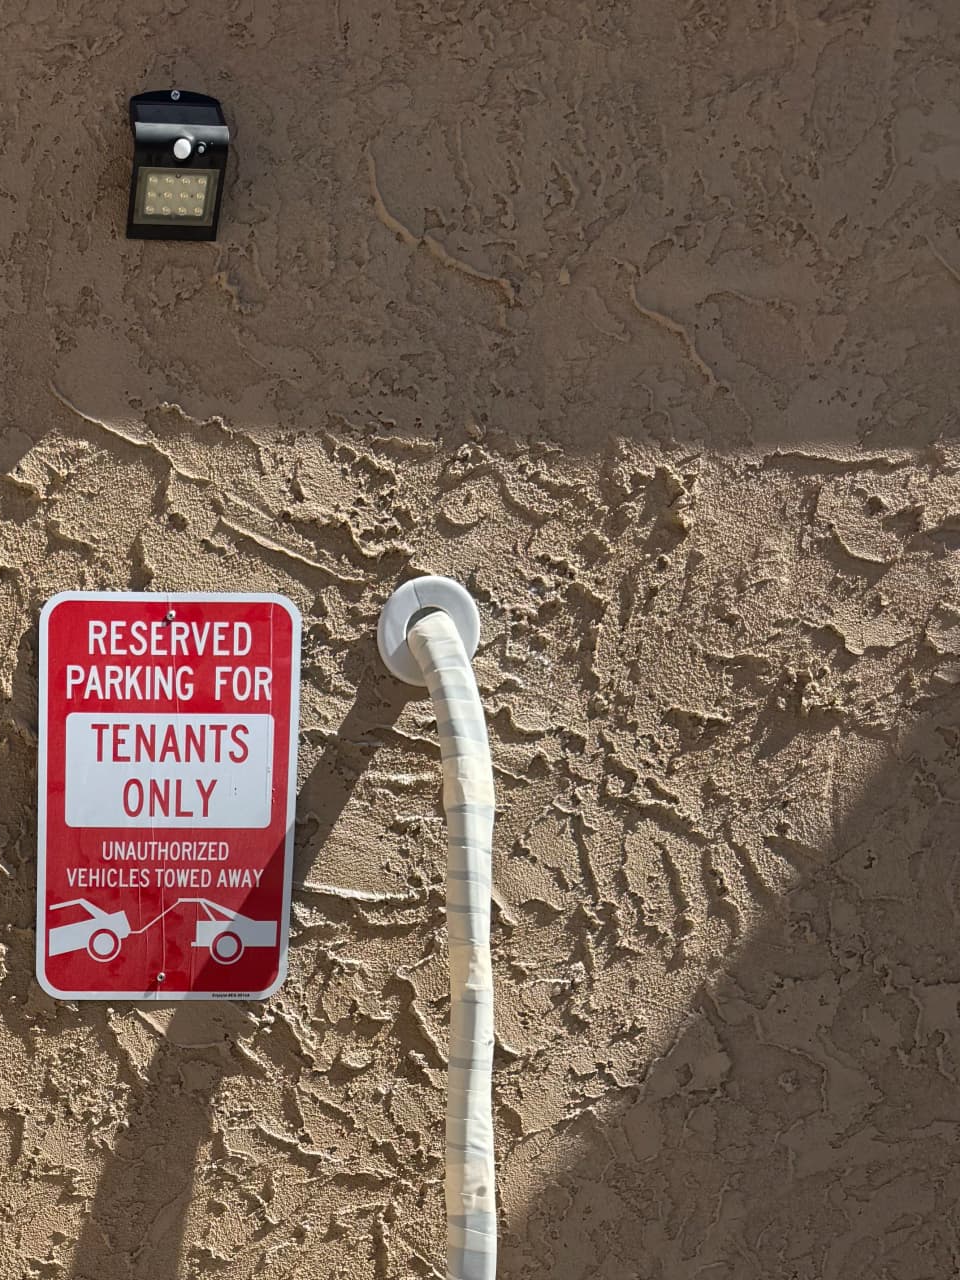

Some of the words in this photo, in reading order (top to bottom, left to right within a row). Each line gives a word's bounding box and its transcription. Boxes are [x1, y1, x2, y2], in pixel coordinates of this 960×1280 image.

[88, 620, 252, 657] RESERVED
[66, 665, 194, 701] PARKING
[215, 666, 273, 701] FOR
[91, 723, 249, 763] TENANTS
[123, 778, 218, 818] ONLY
[101, 841, 230, 861] UNAUTHORIZED
[66, 868, 150, 888] VEHICLES
[154, 868, 212, 888] TOWED
[216, 868, 264, 889] AWAY
